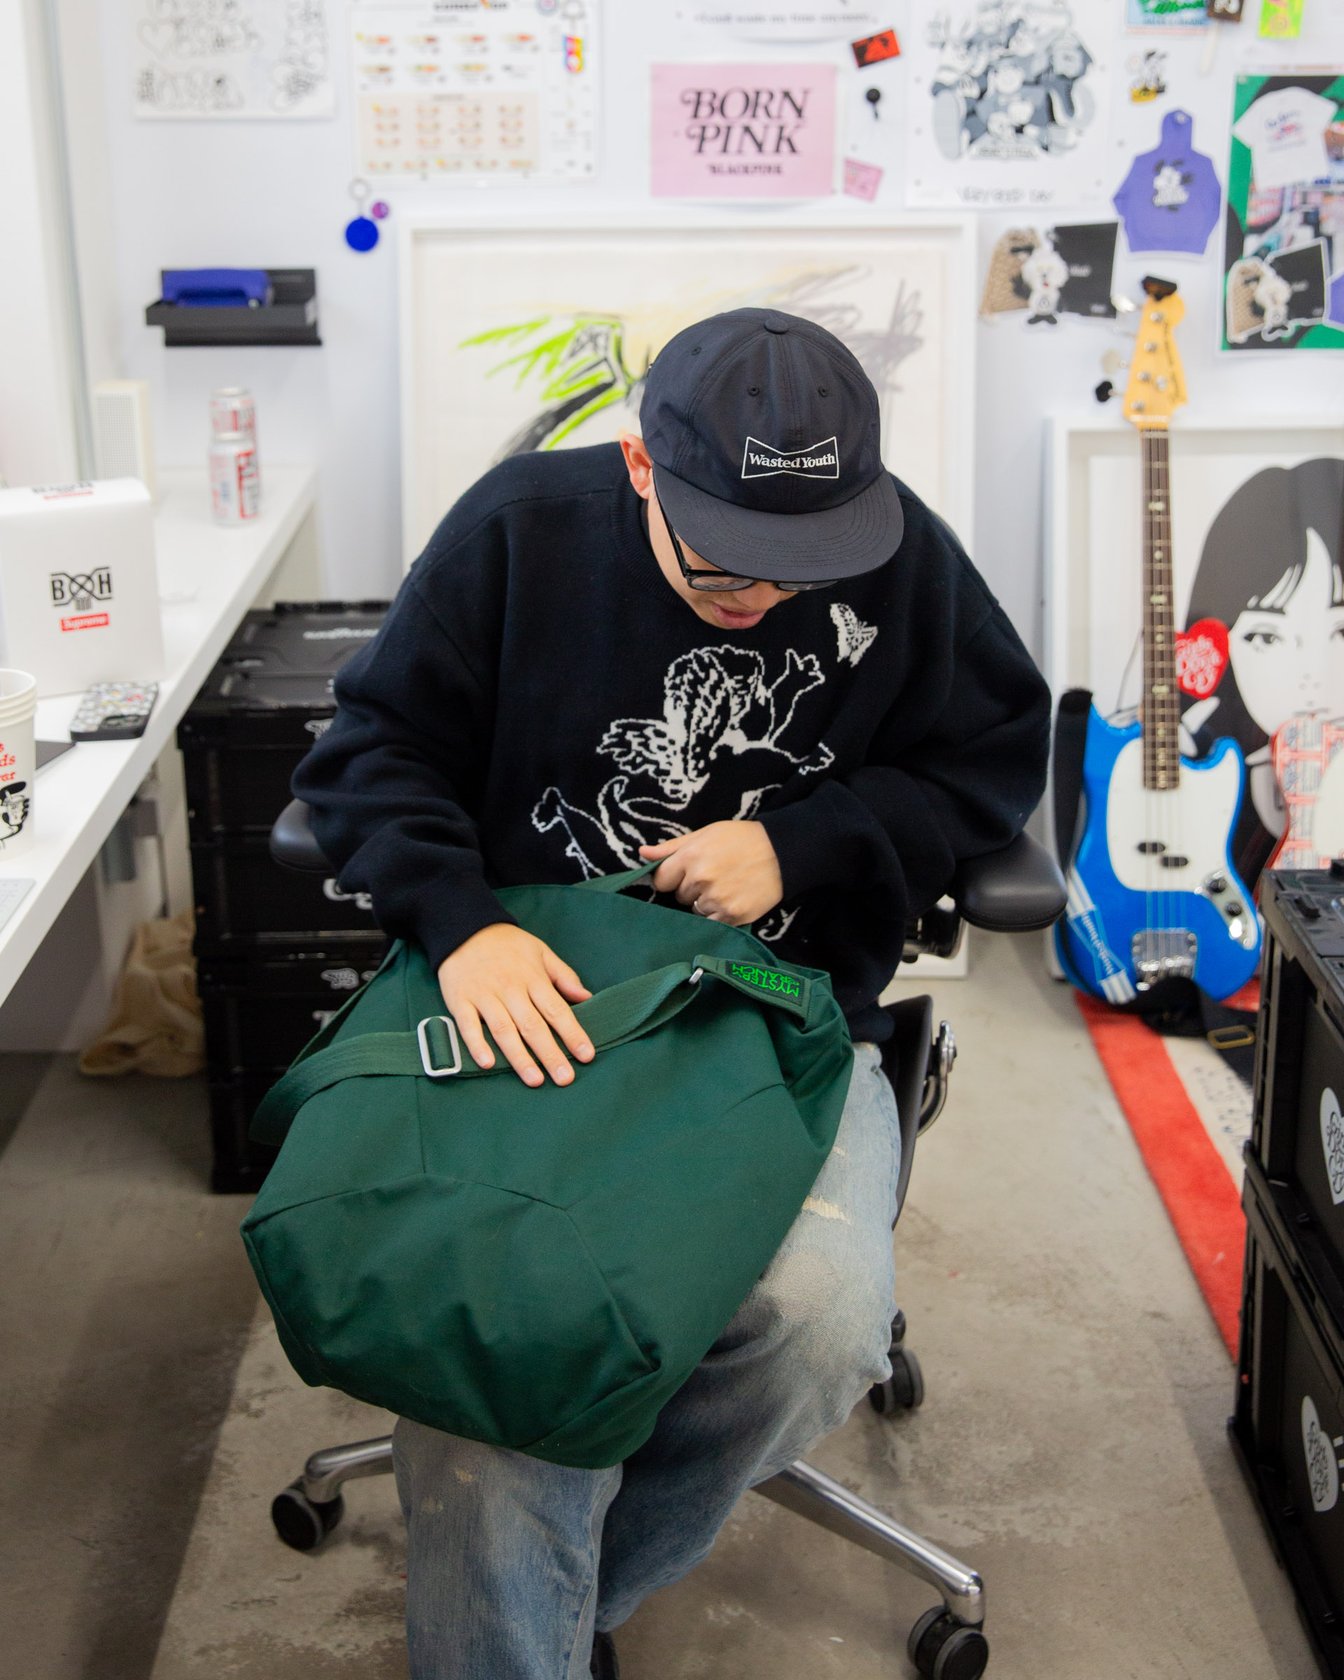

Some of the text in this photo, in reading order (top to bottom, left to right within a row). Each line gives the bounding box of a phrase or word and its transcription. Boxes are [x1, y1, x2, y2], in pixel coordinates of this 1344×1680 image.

[681, 87, 812, 119] BORN
[685, 122, 806, 154] PINK
[748, 453, 836, 468] Wasted Youth
[731, 969, 800, 998] MYSTERY
